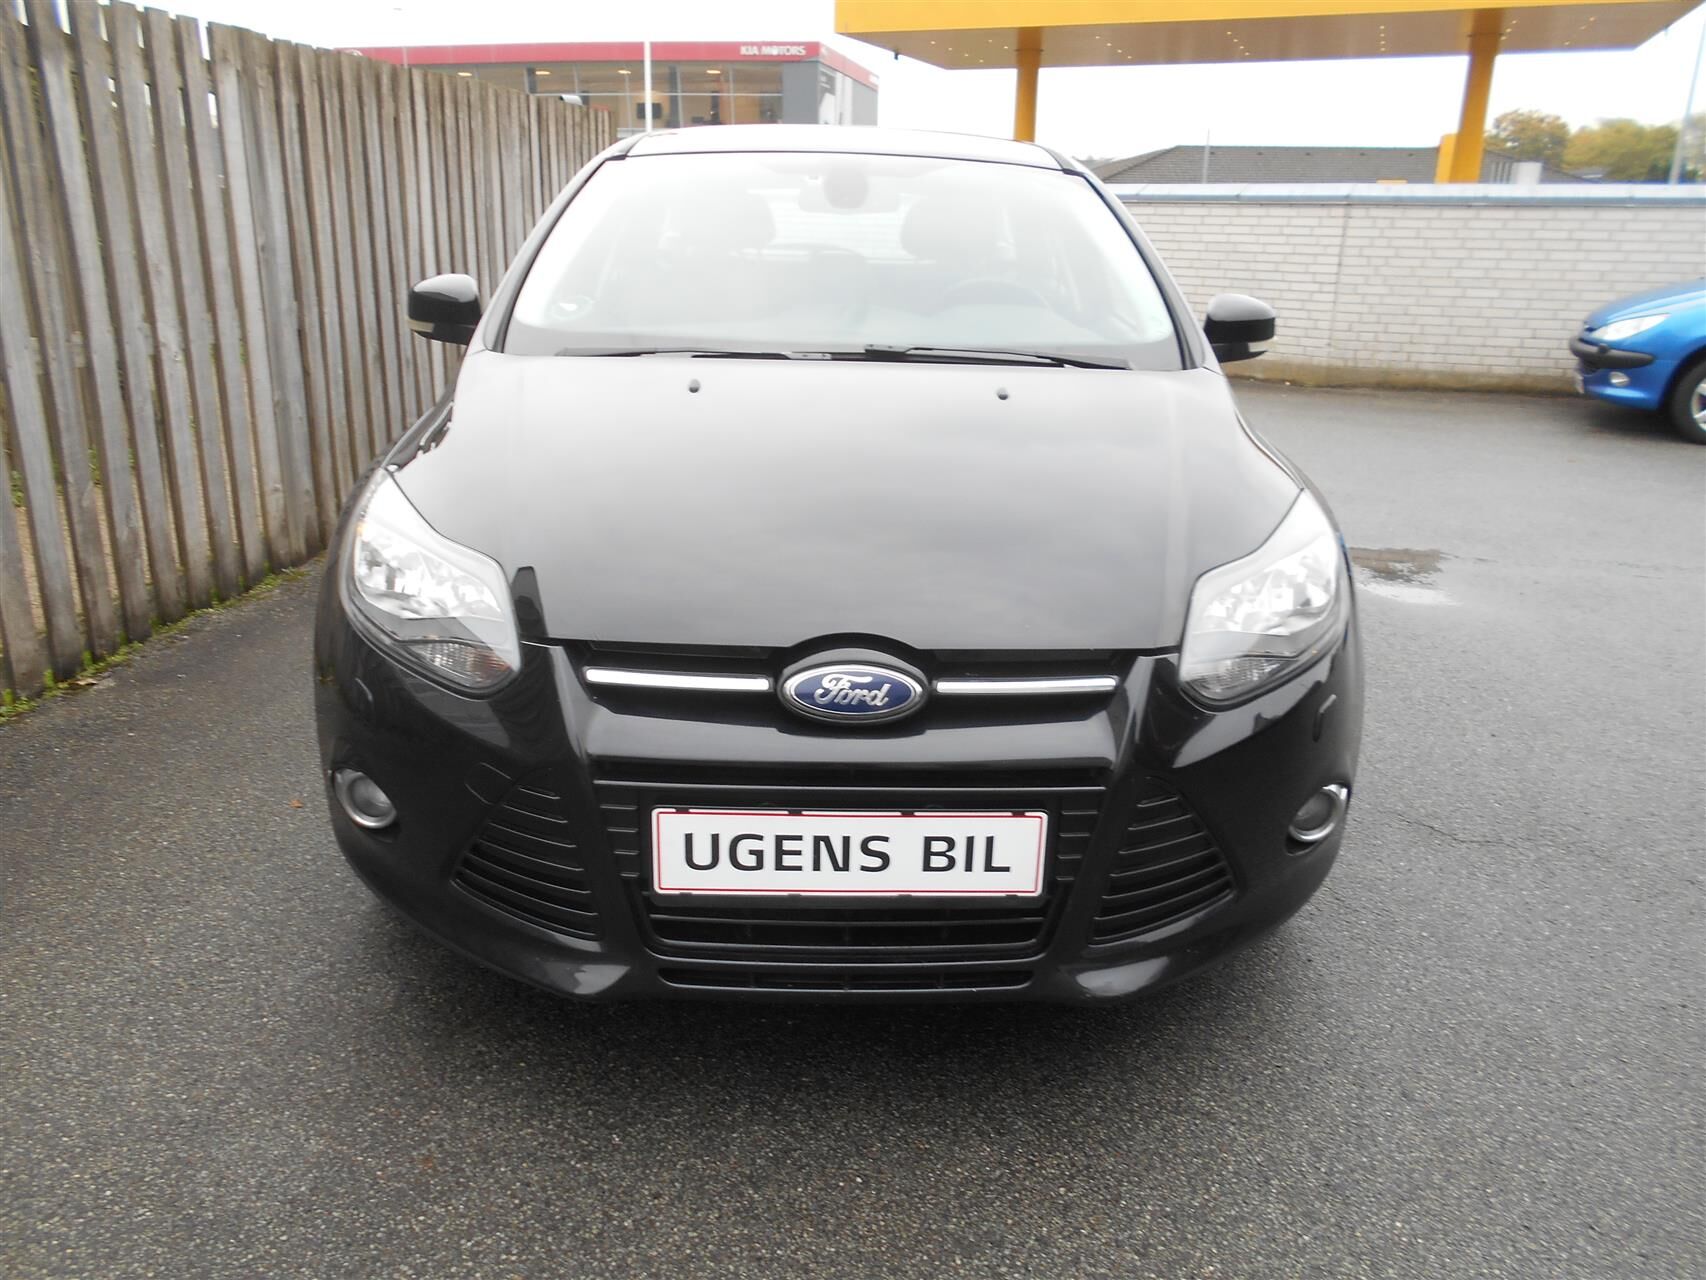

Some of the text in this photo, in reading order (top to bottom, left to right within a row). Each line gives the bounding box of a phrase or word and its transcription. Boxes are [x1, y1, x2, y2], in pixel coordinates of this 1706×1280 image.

[740, 45, 806, 56] KIA MOTORS
[814, 673, 892, 706] Ford
[684, 832, 1011, 873] UGENS BIL
